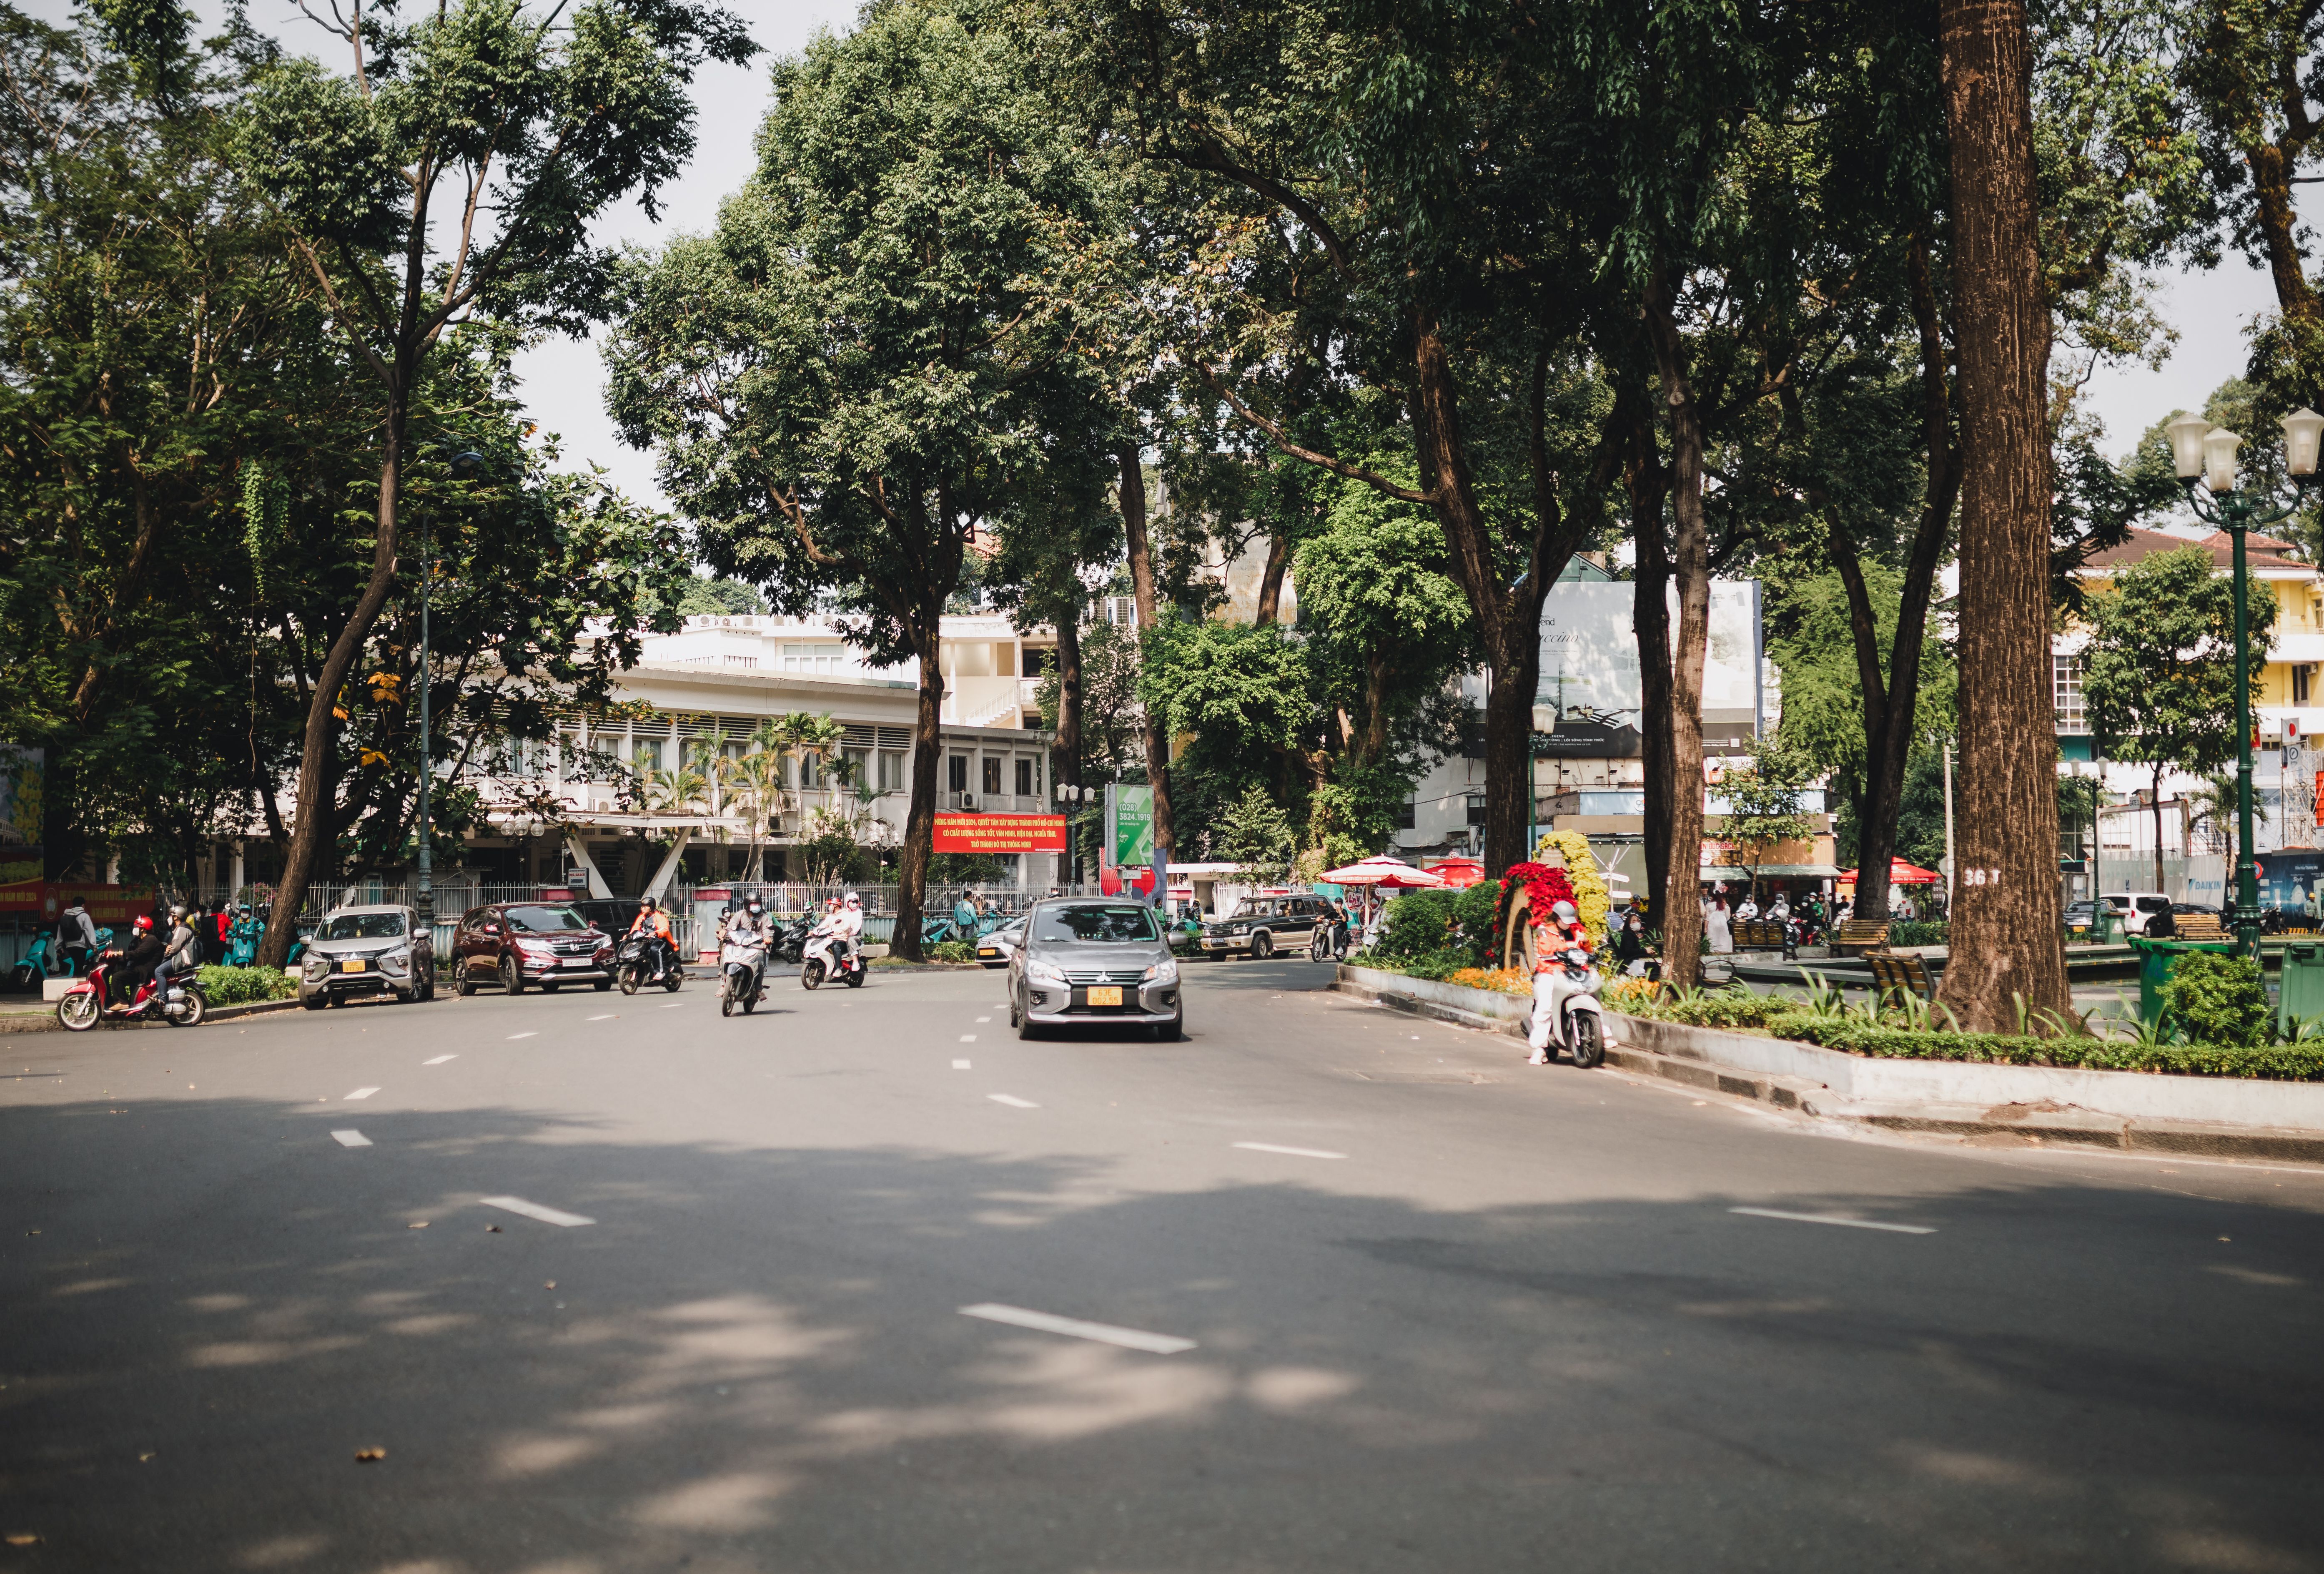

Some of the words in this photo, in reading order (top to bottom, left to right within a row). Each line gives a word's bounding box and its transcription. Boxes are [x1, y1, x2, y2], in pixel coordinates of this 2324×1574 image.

[1119, 803, 1137, 812] (028)
[978, 817, 990, 826] QUYẾT
[1119, 813, 1151, 821] 3824.1919
[950, 828, 960, 837] CHẤT
[961, 830, 975, 838] LƯỢNG
[975, 828, 986, 837] SỐNG
[987, 828, 995, 837] TỐT,
[1017, 829, 1025, 838] HIỆN
[1964, 869, 1986, 886] 36
[2195, 881, 2221, 890] DAIKIN
[26, 892, 36, 901] 2024
